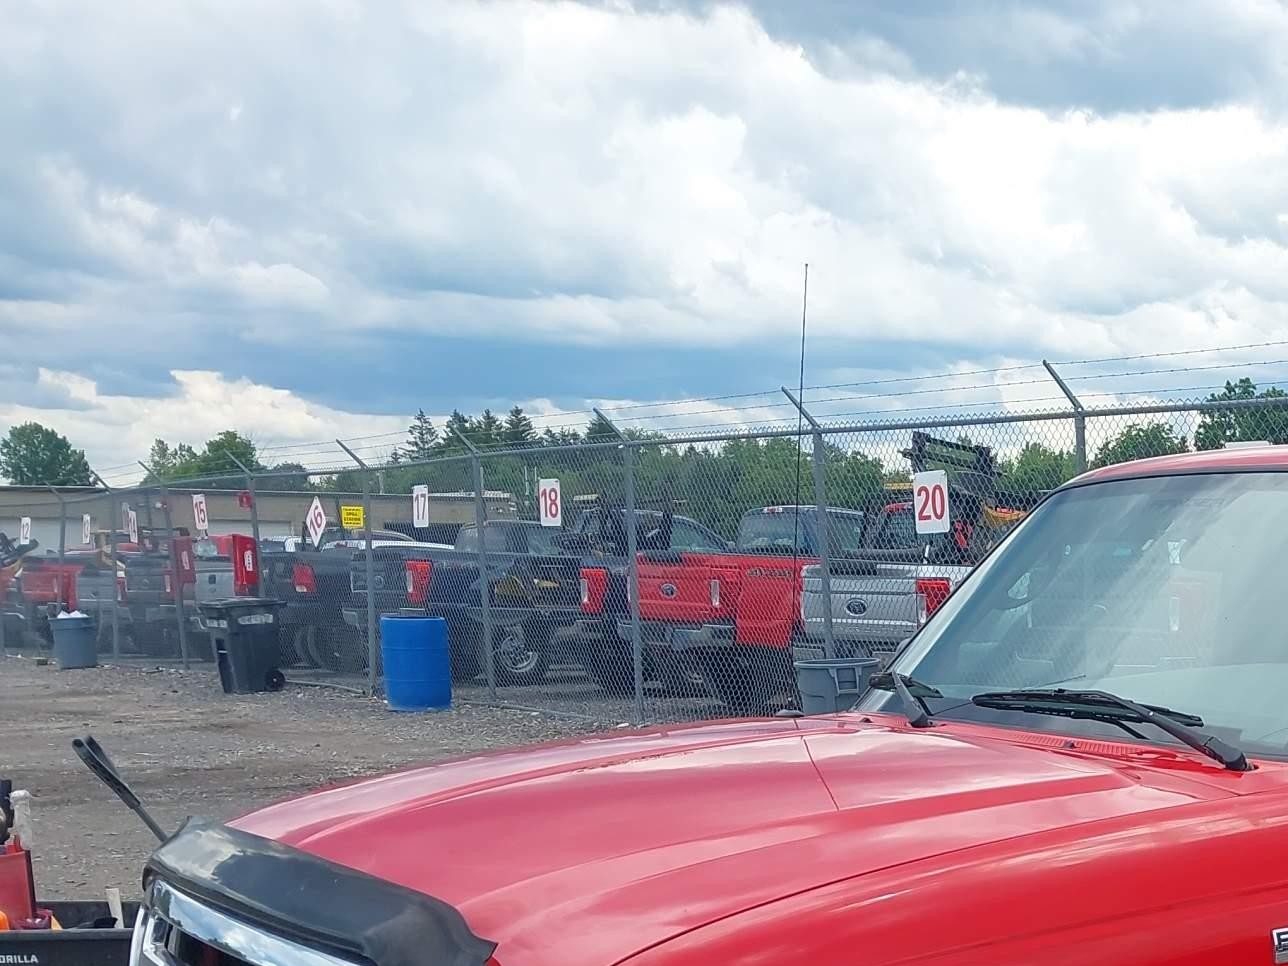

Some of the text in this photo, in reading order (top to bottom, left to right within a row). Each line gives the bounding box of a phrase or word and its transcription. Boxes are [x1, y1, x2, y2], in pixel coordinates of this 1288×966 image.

[194, 500, 207, 525] 15
[414, 493, 427, 521] 17
[540, 487, 559, 519] 18
[917, 484, 946, 521] 20
[22, 522, 30, 540] 12
[309, 505, 323, 537] 16
